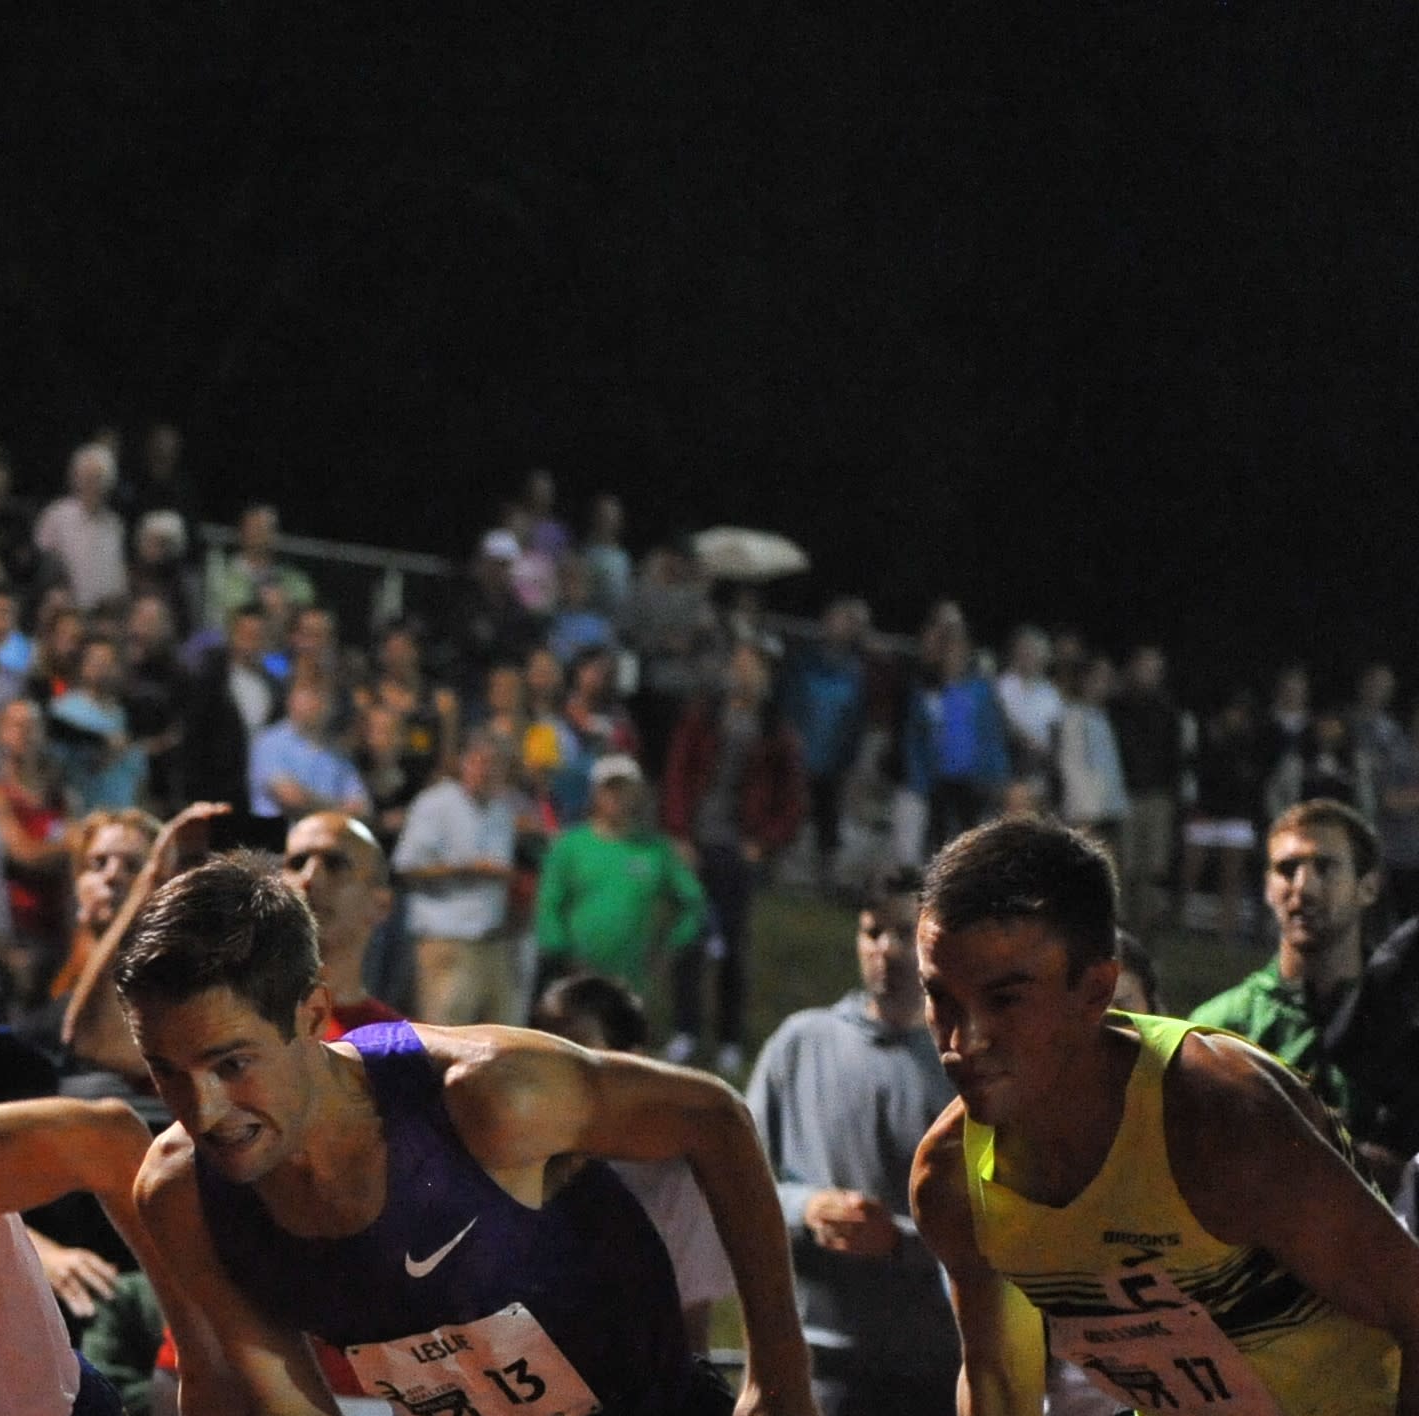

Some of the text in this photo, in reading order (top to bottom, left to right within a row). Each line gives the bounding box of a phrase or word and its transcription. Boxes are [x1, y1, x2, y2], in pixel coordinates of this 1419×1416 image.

[1103, 1231, 1181, 1247] BROOKS
[410, 1333, 475, 1364] LESLIE
[482, 1356, 547, 1404] 13
[1172, 1356, 1232, 1403] 17
